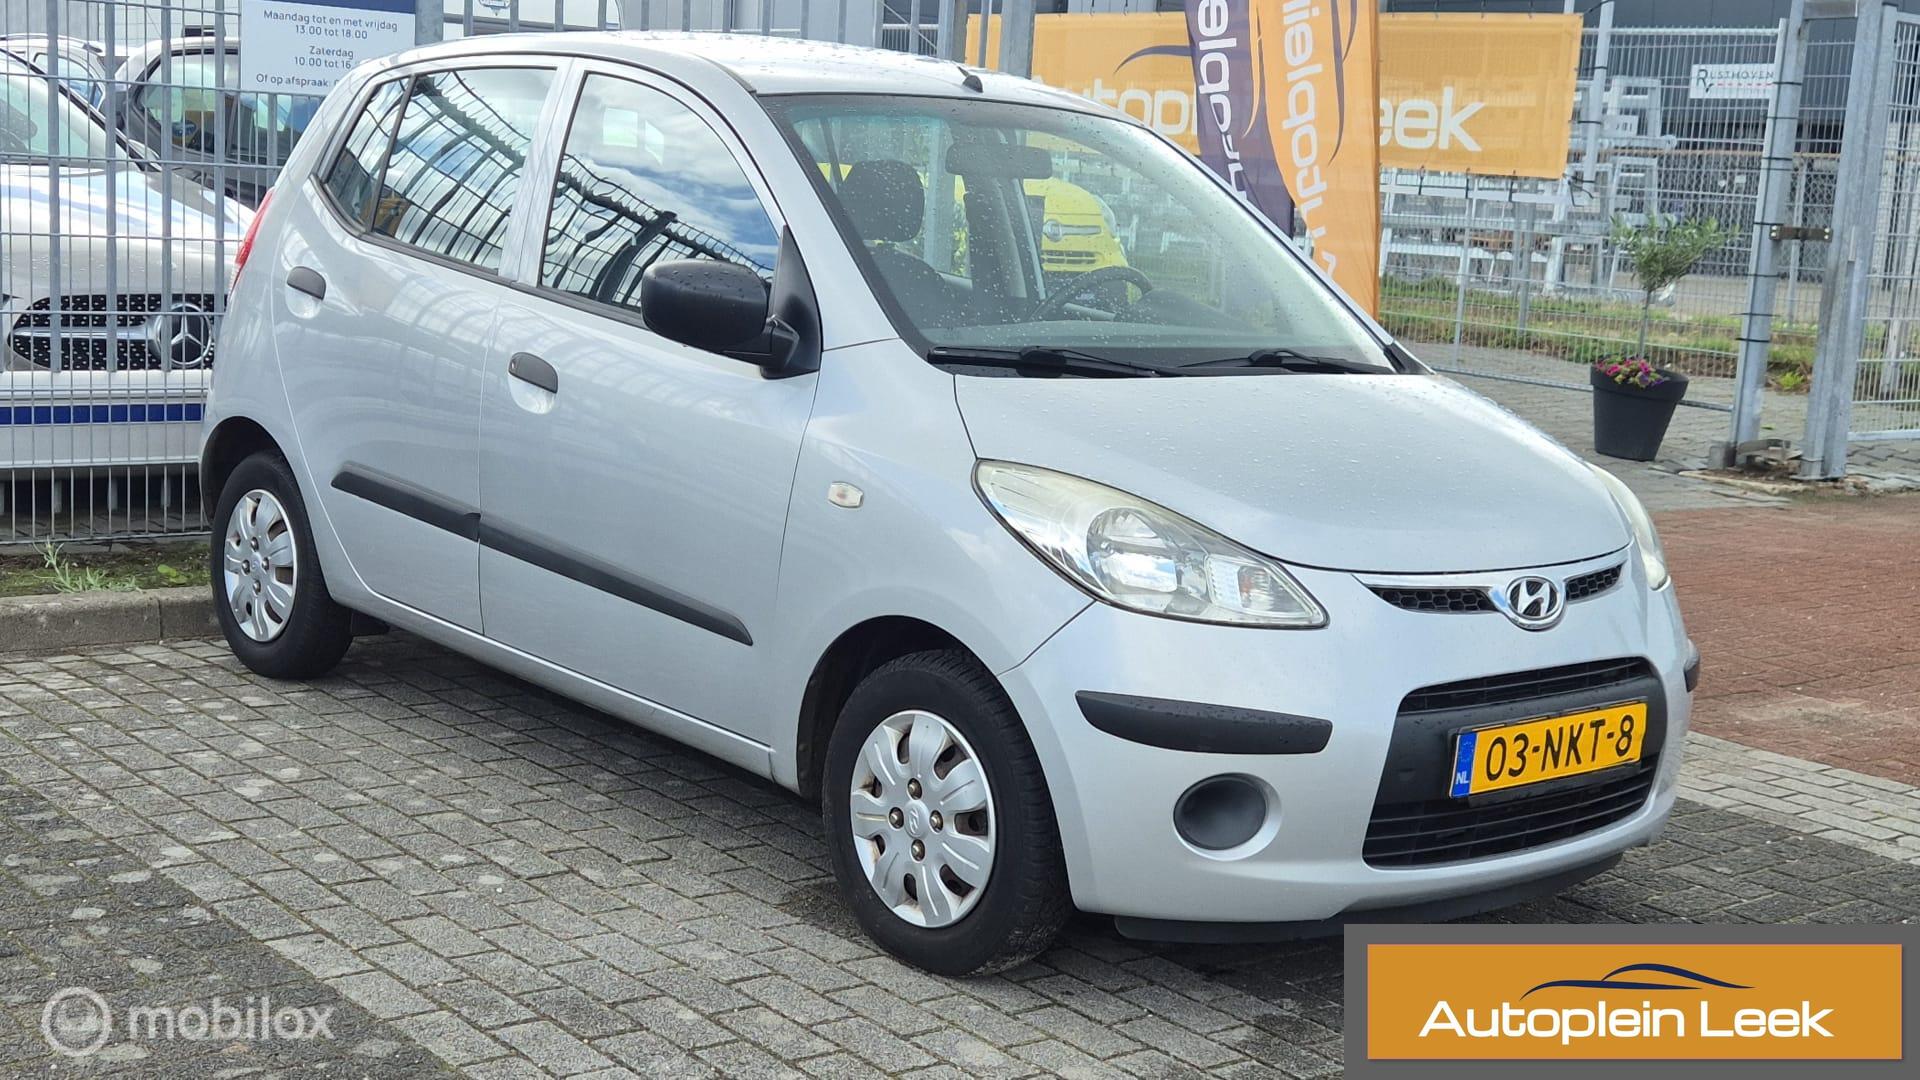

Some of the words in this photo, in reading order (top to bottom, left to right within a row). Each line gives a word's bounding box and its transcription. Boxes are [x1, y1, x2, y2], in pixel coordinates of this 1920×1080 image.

[263, 10, 310, 24] Maandag
[312, 14, 326, 24] tot
[329, 16, 341, 25] en
[343, 18, 362, 27] met
[365, 20, 398, 33] vrijdag
[324, 28, 338, 37] tot
[309, 45, 354, 60] Zaterdag
[324, 58, 339, 69] tot
[255, 73, 268, 83] Of
[270, 76, 284, 86] op
[1485, 714, 1636, 781] 03-NKT-8
[1455, 771, 1470, 785] NL
